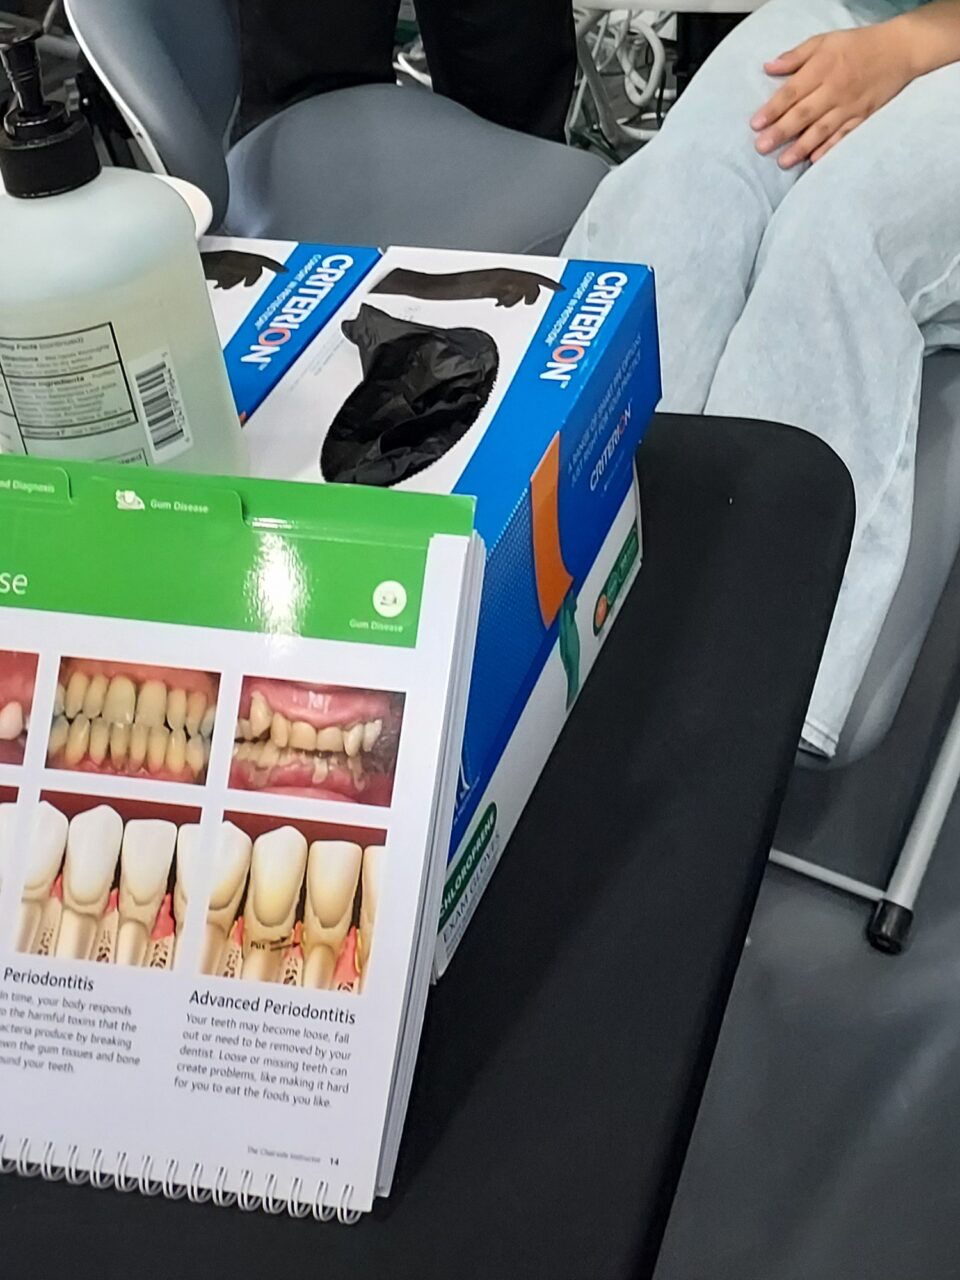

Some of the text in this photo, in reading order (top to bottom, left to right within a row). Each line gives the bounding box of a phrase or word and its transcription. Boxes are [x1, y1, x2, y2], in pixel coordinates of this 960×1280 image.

[240, 253, 355, 365] CRITERION
[539, 271, 629, 382] CRITERION
[150, 499, 209, 514] Gum Disease
[4, 966, 95, 992] Periodontitis
[10, 1006, 25, 1018] the
[28, 1009, 65, 1024] harmful
[99, 1018, 118, 1031] that
[121, 1021, 137, 1033] the
[62, 998, 85, 1012] body
[89, 1003, 132, 1017] responds
[188, 989, 357, 1025] Advanced Periodontitis
[34, 1028, 74, 1040] produce
[76, 1031, 88, 1044] by
[90, 1034, 132, 1051] breaking
[187, 1013, 350, 1044] Your teeth may become loose, fall
[20, 1040, 35, 1052] the
[96, 1051, 114, 1063] and
[116, 1054, 140, 1066] bone
[182, 1031, 352, 1062] out or need to be removed by your
[218, 1050, 248, 1064] Loose
[250, 1055, 261, 1065] or
[263, 1056, 299, 1071] missing
[302, 1061, 328, 1075] teeth
[330, 1066, 348, 1077] can
[176, 1062, 349, 1094] create problems, like making it hard
[174, 1077, 189, 1088] for
[191, 1080, 209, 1092] you
[212, 1082, 223, 1093] to
[225, 1084, 240, 1096] eat
[243, 1085, 260, 1099] the
[262, 1087, 291, 1103] foods
[292, 1095, 311, 1107] you
[330, 1157, 339, 1166] 14
